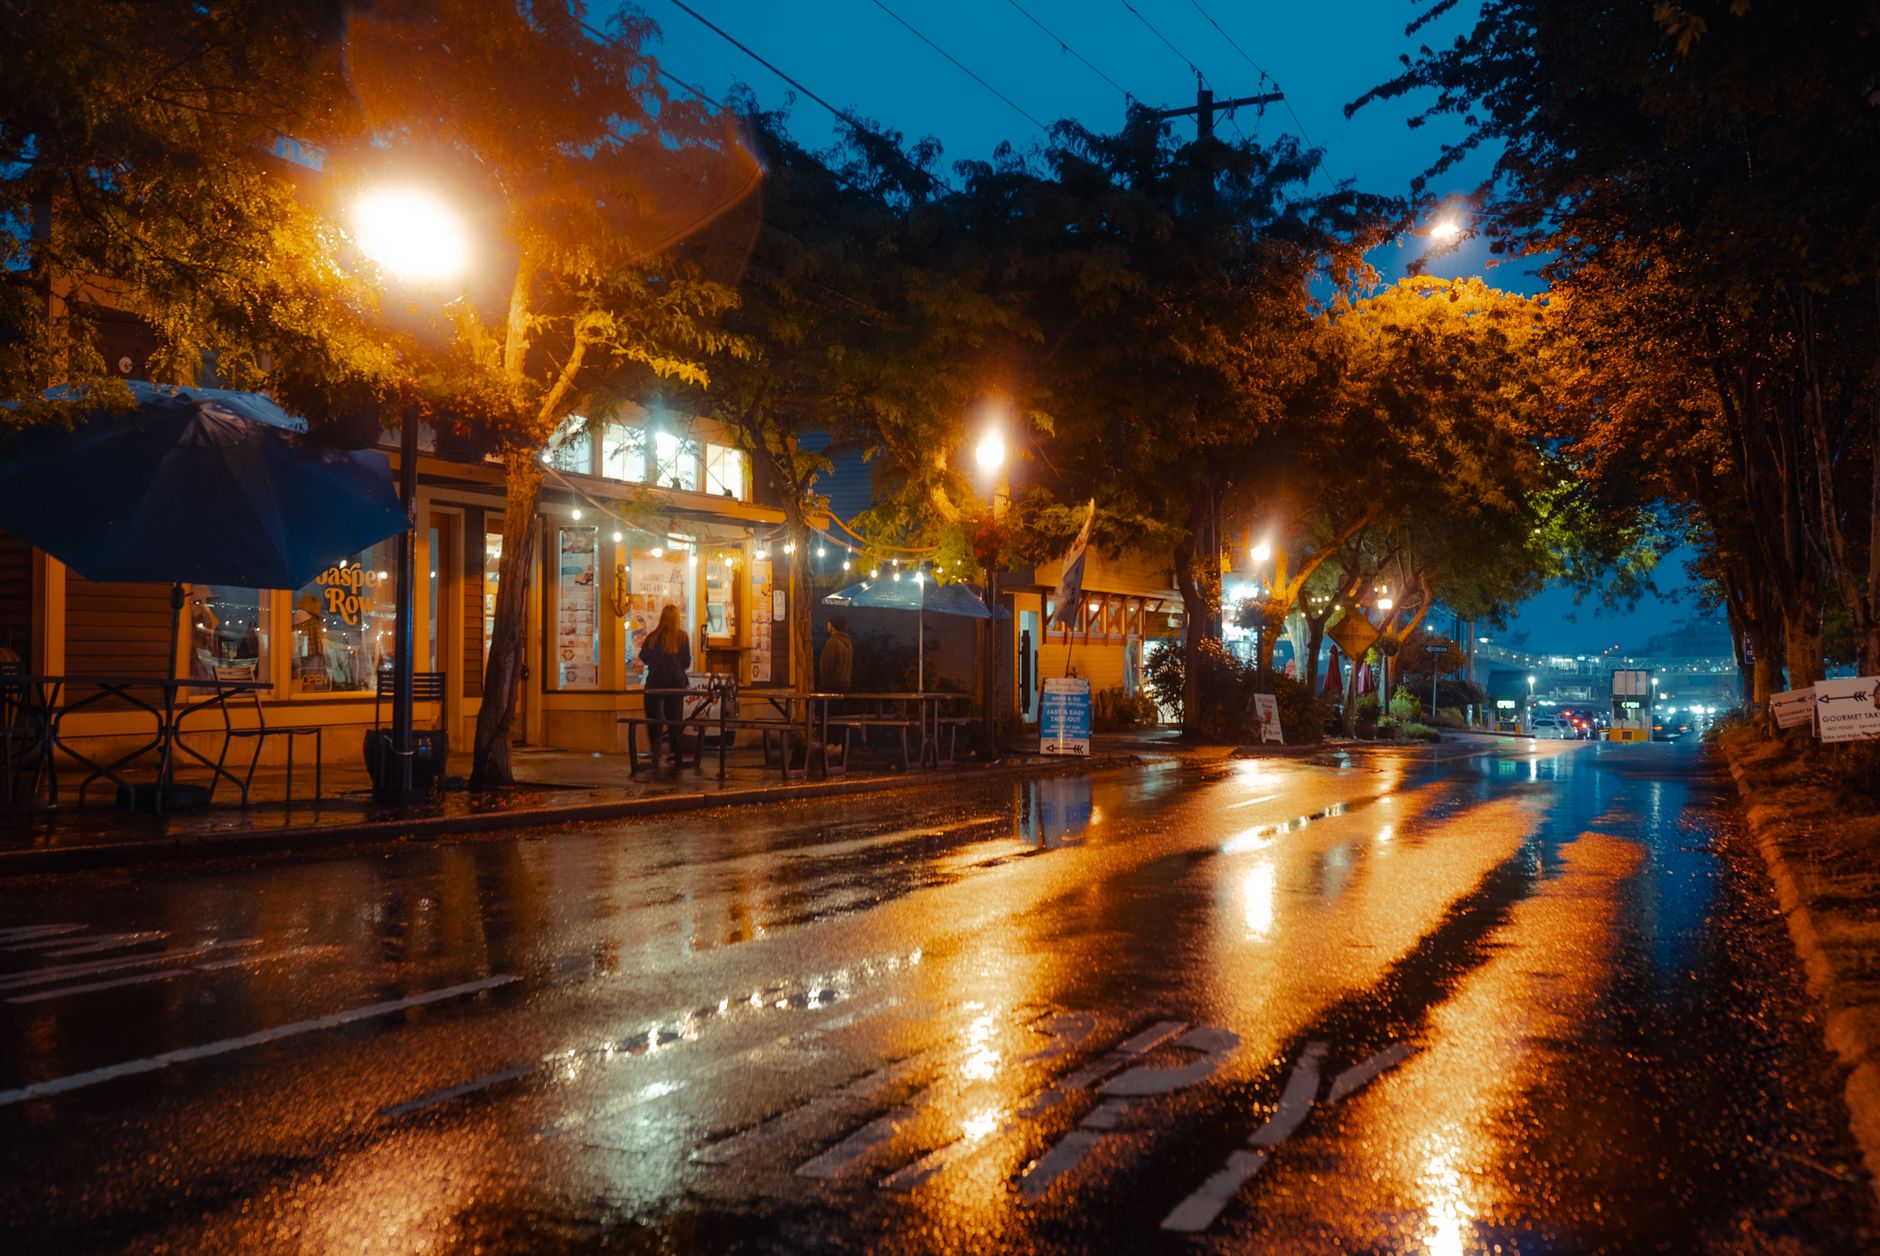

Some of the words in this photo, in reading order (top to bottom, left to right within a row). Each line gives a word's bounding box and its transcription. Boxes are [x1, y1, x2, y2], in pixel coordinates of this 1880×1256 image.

[315, 562, 388, 594] Jaspe
[324, 587, 374, 625] Row
[1497, 700, 1516, 709] OPEN
[1822, 713, 1862, 723] GOURMET
[1864, 711, 1880, 720] TAK
